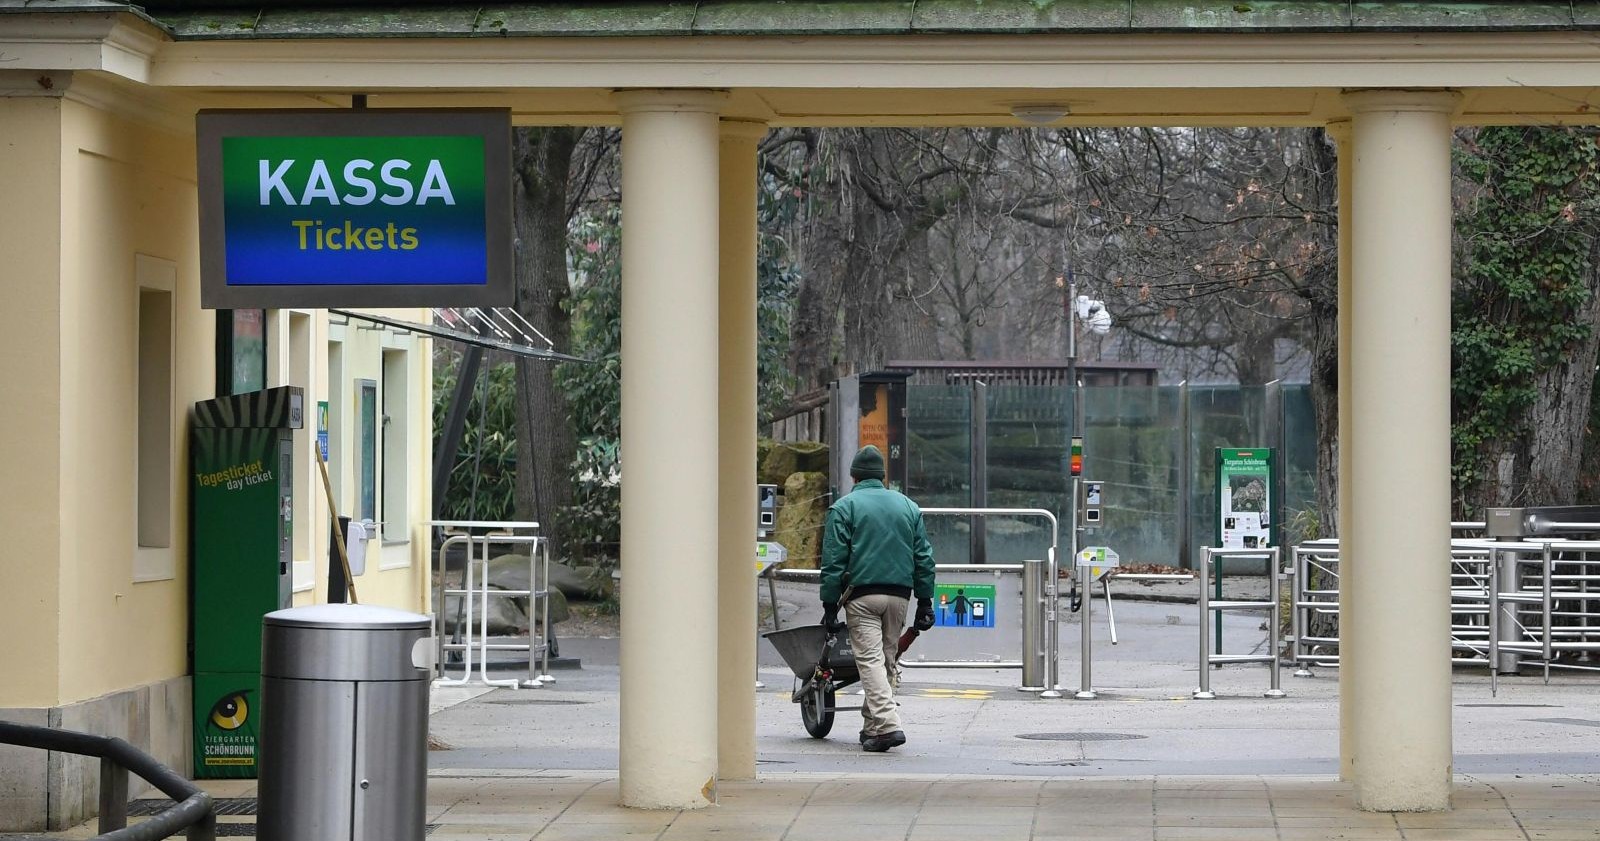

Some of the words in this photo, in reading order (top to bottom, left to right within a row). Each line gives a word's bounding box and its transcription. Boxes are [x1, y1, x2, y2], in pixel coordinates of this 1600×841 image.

[259, 159, 456, 206] KASSA
[292, 220, 419, 250] Tickets
[196, 460, 263, 487] Tagesticket
[226, 478, 243, 491] day
[244, 470, 273, 485] ticket
[205, 744, 255, 755] SCHÖNBRUNN
